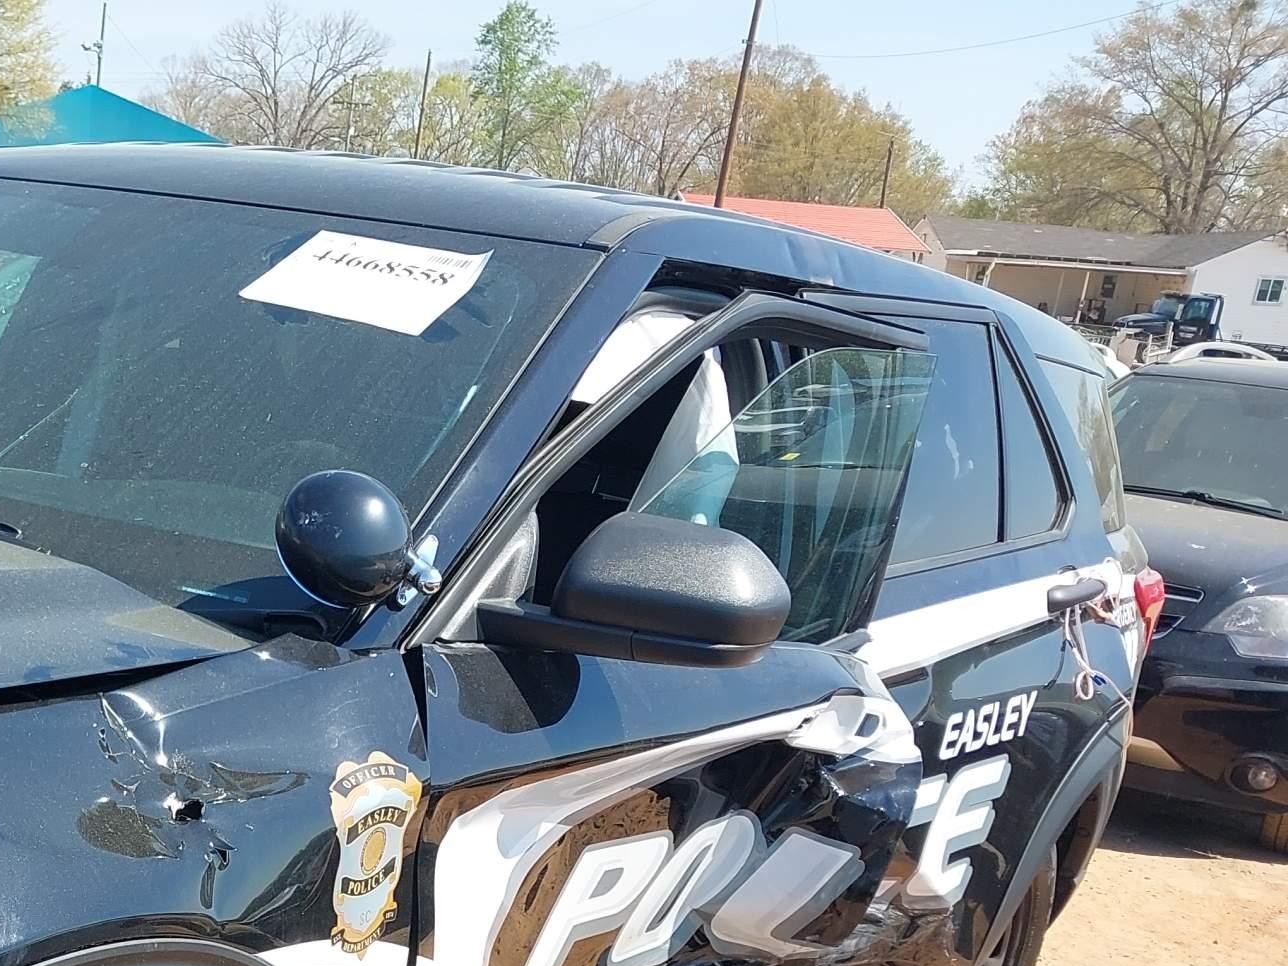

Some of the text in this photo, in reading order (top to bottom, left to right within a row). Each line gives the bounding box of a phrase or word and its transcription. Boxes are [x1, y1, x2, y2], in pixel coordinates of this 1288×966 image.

[313, 250, 455, 285] 44668558
[938, 689, 1039, 761] EASLEY
[341, 764, 396, 789] OFFICER
[357, 807, 402, 834] EASLEY
[347, 869, 386, 895] POLICE
